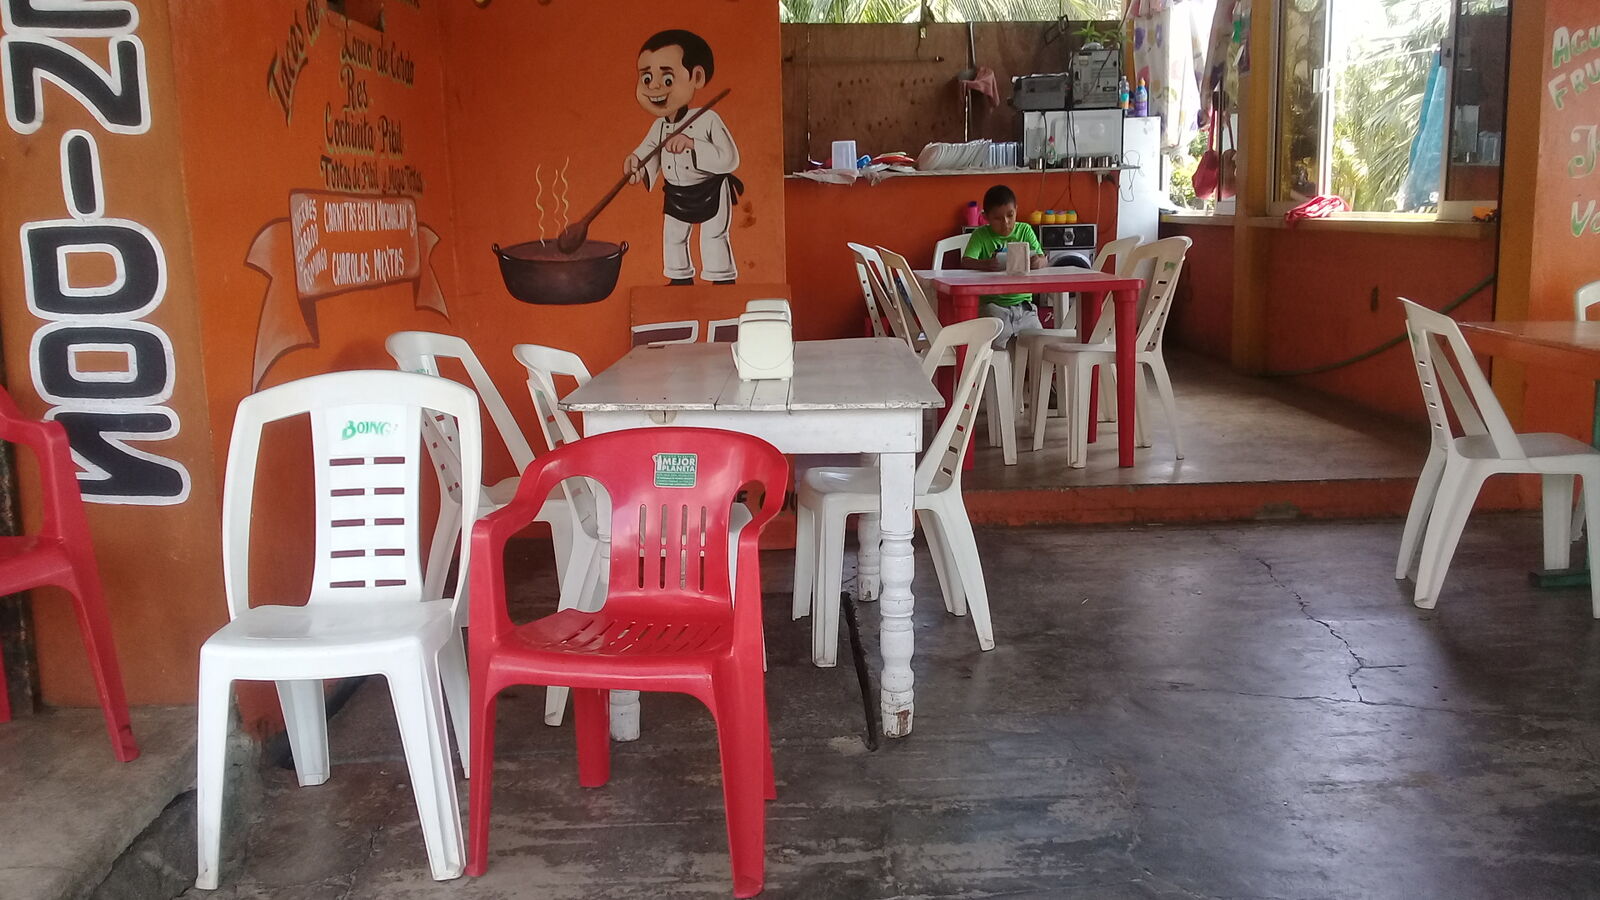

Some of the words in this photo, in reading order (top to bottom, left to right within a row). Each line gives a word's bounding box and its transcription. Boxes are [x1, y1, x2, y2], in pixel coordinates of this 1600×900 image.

[340, 64, 368, 112] Res
[324, 102, 374, 156] Cochinita
[378, 115, 403, 158] Pibil
[331, 251, 371, 286] CHAROLAS
[373, 246, 405, 283] MIXTAS
[662, 457, 695, 466] MEJOR
